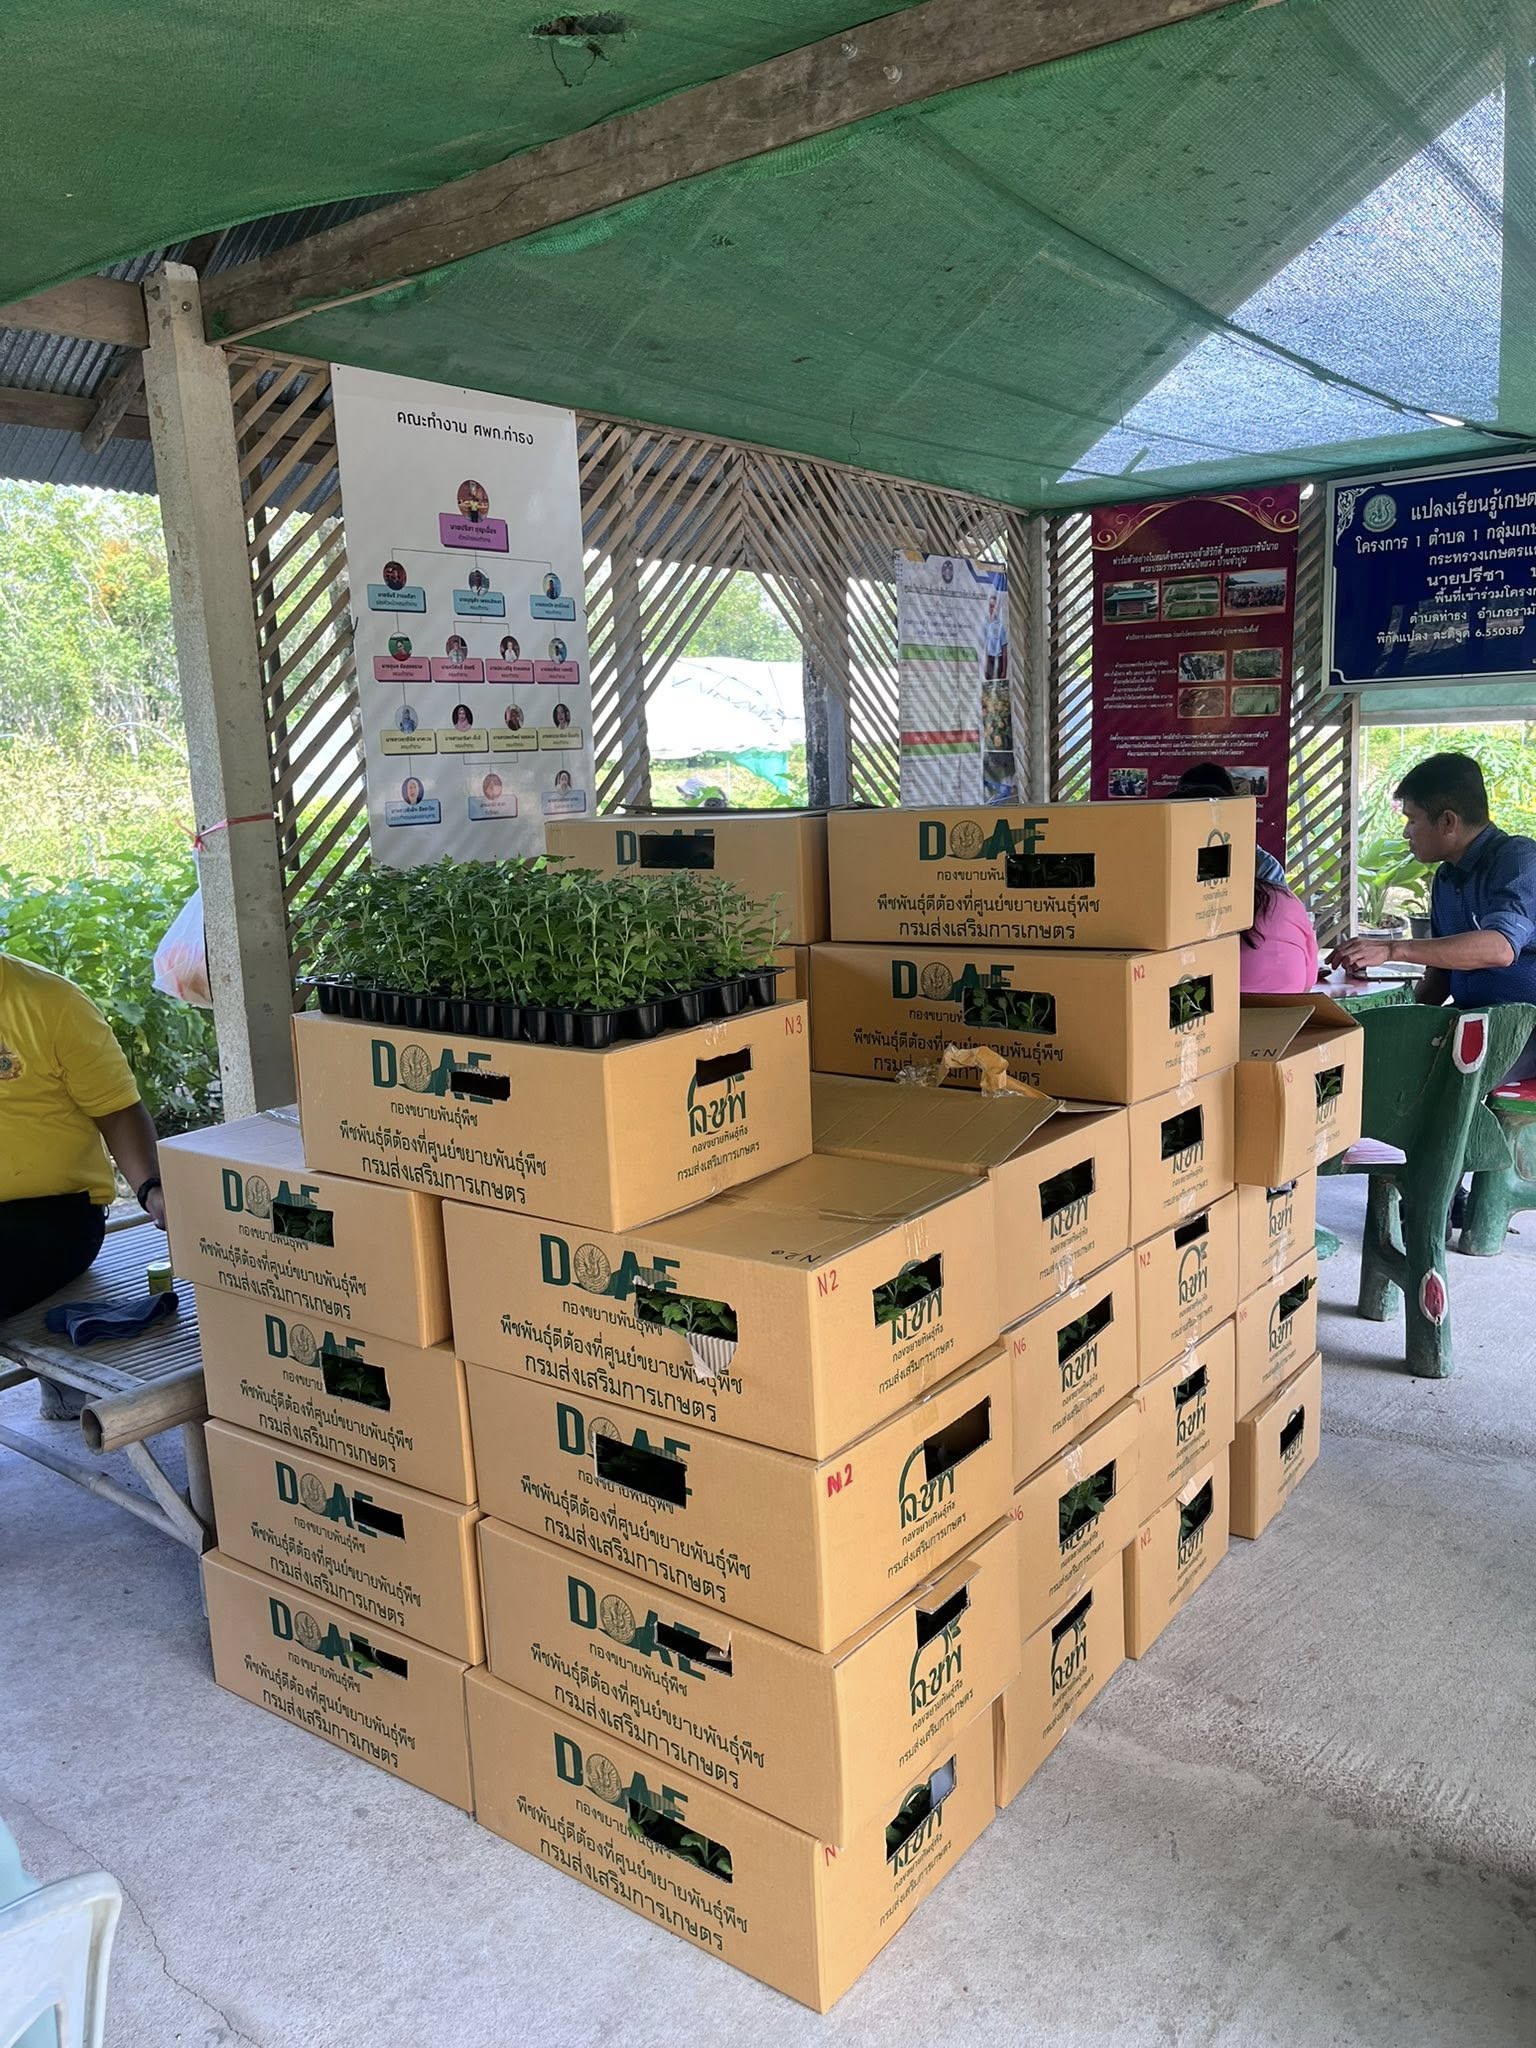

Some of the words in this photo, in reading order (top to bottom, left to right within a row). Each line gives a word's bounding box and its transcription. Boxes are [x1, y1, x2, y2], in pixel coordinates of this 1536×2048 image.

[397, 410, 467, 434] คณะทำงาน
[474, 423, 534, 445] ศพก.ท่าธง
[1356, 536, 1408, 554] โครงการ
[1416, 536, 1421, 548] 1
[1429, 527, 1465, 546] ตำบล
[1473, 529, 1478, 541] 1
[1426, 566, 1504, 586] นายปรีชา
[1376, 630, 1428, 644] พิกัดแปลง
[1475, 626, 1526, 637] 6.550387
[1410, 610, 1467, 624] ตำบลท่าธง
[899, 918, 1076, 941] กรมส่งเสริมการเกษตร
[785, 1015, 803, 1036] N3
[390, 1100, 478, 1130] กองขยายพันธุ์พืช
[340, 1119, 546, 1180] พืชพันธุ์ดีต้องที่ศูนย์ขยายพันธุ์พืช
[362, 1155, 526, 1204] กรมส่งเสริมการเกษตร
[218, 1270, 351, 1320] กรมส่งเสริมการเกษตร
[817, 1269, 839, 1297] N2
[1013, 1338, 1027, 1358] N6
[525, 1353, 717, 1423] กรมส่งเสริมการเกษตร
[259, 1412, 396, 1473] กรมส่งเสริมการเกษตร
[827, 1463, 853, 1498] N2
[294, 1516, 366, 1554] กองขยายพันธุ์พืช
[521, 1475, 751, 1580] พืชพันธุ์ดีต้องที่ศูนย์ขยายพันธุ์พืช
[545, 1515, 726, 1603] กรมส่งเสริมการเกษตร
[270, 1555, 405, 1626] กรมส่งเสริมการเกษตร
[288, 1651, 360, 1693] กองขยายพันธุ์พืช
[589, 1642, 688, 1697] กองขยายพันธุ์พืช
[263, 1688, 398, 1769] กรมส่งเสริมการเกษตร
[531, 1642, 765, 1768] พืชพันธุ์ดีต้องที่ศูนย์ขยายพันธุ์พืช
[555, 1684, 739, 1789] กรมส่งเสริมการเกษตร
[517, 1794, 748, 1934] พืชพันธุ์ดีต้องที่ศูนย์ขยายพันธุ์พืช
[540, 1836, 723, 1951] กรมส่งเสริมการเกษตร
